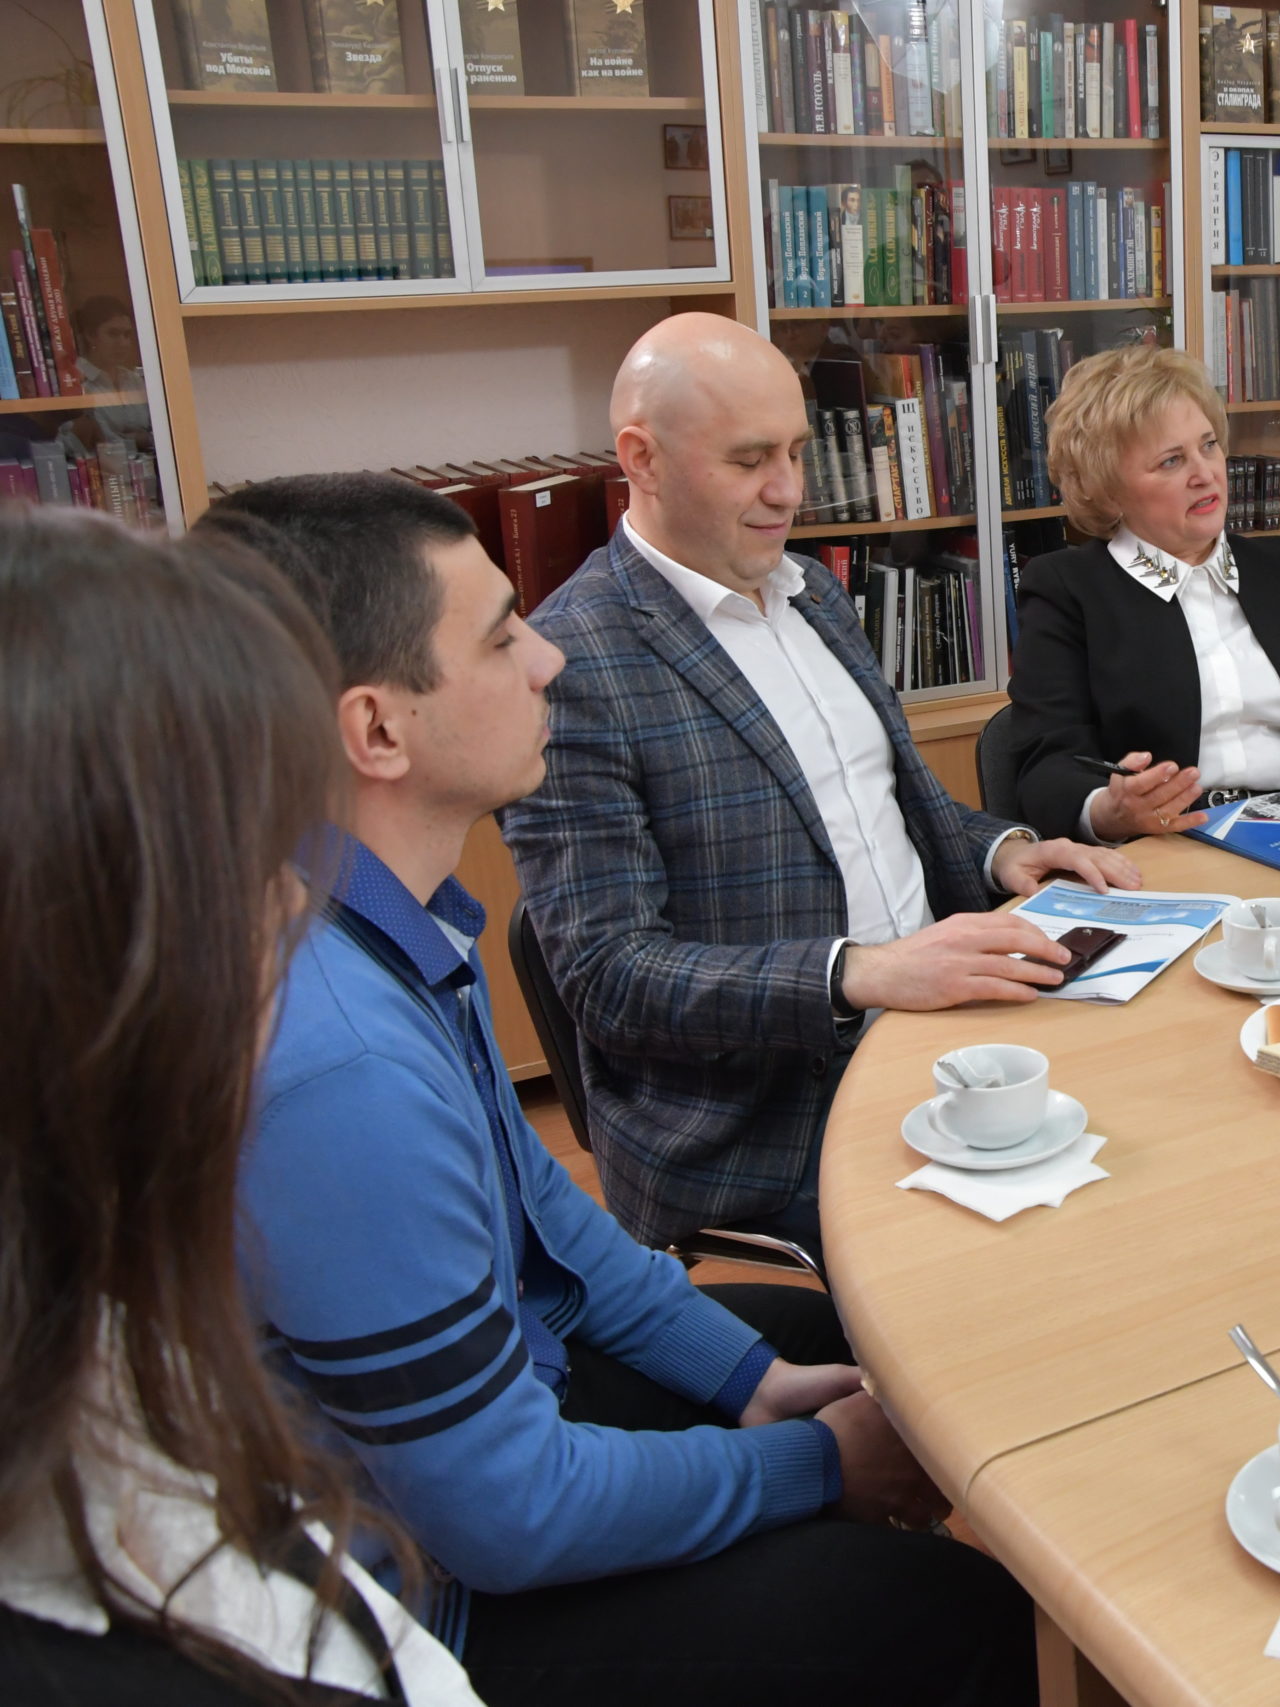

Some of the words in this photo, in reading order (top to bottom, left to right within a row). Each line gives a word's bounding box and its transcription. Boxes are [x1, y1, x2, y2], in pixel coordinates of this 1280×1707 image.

[219, 52, 254, 65] Убиты
[345, 51, 382, 62] Звезда
[589, 57, 602, 66] На
[604, 56, 633, 66] войне
[205, 64, 225, 76] под
[226, 63, 271, 77] Москвой
[466, 62, 504, 74] Отпуск
[581, 69, 599, 77] как
[601, 69, 613, 77] на
[614, 67, 644, 77] войне
[470, 75, 517, 85] ранению
[813, 70, 824, 111] ГОГОЛЬ
[1217, 93, 1261, 109] СТАЛИНГРАДА
[1212, 151, 1219, 161] Э
[782, 211, 793, 257] Поплавский
[797, 210, 806, 257] Поплавский
[814, 211, 824, 257] Поплавский
[785, 259, 795, 282] Борис
[817, 258, 826, 281] Борис
[48, 300, 60, 327] ДВУМЯ
[902, 402, 917, 415] Щ
[907, 424, 923, 515] ИСКУССТВО
[893, 465, 903, 509] СПАРТАК
[1009, 541, 1018, 565] YURY
